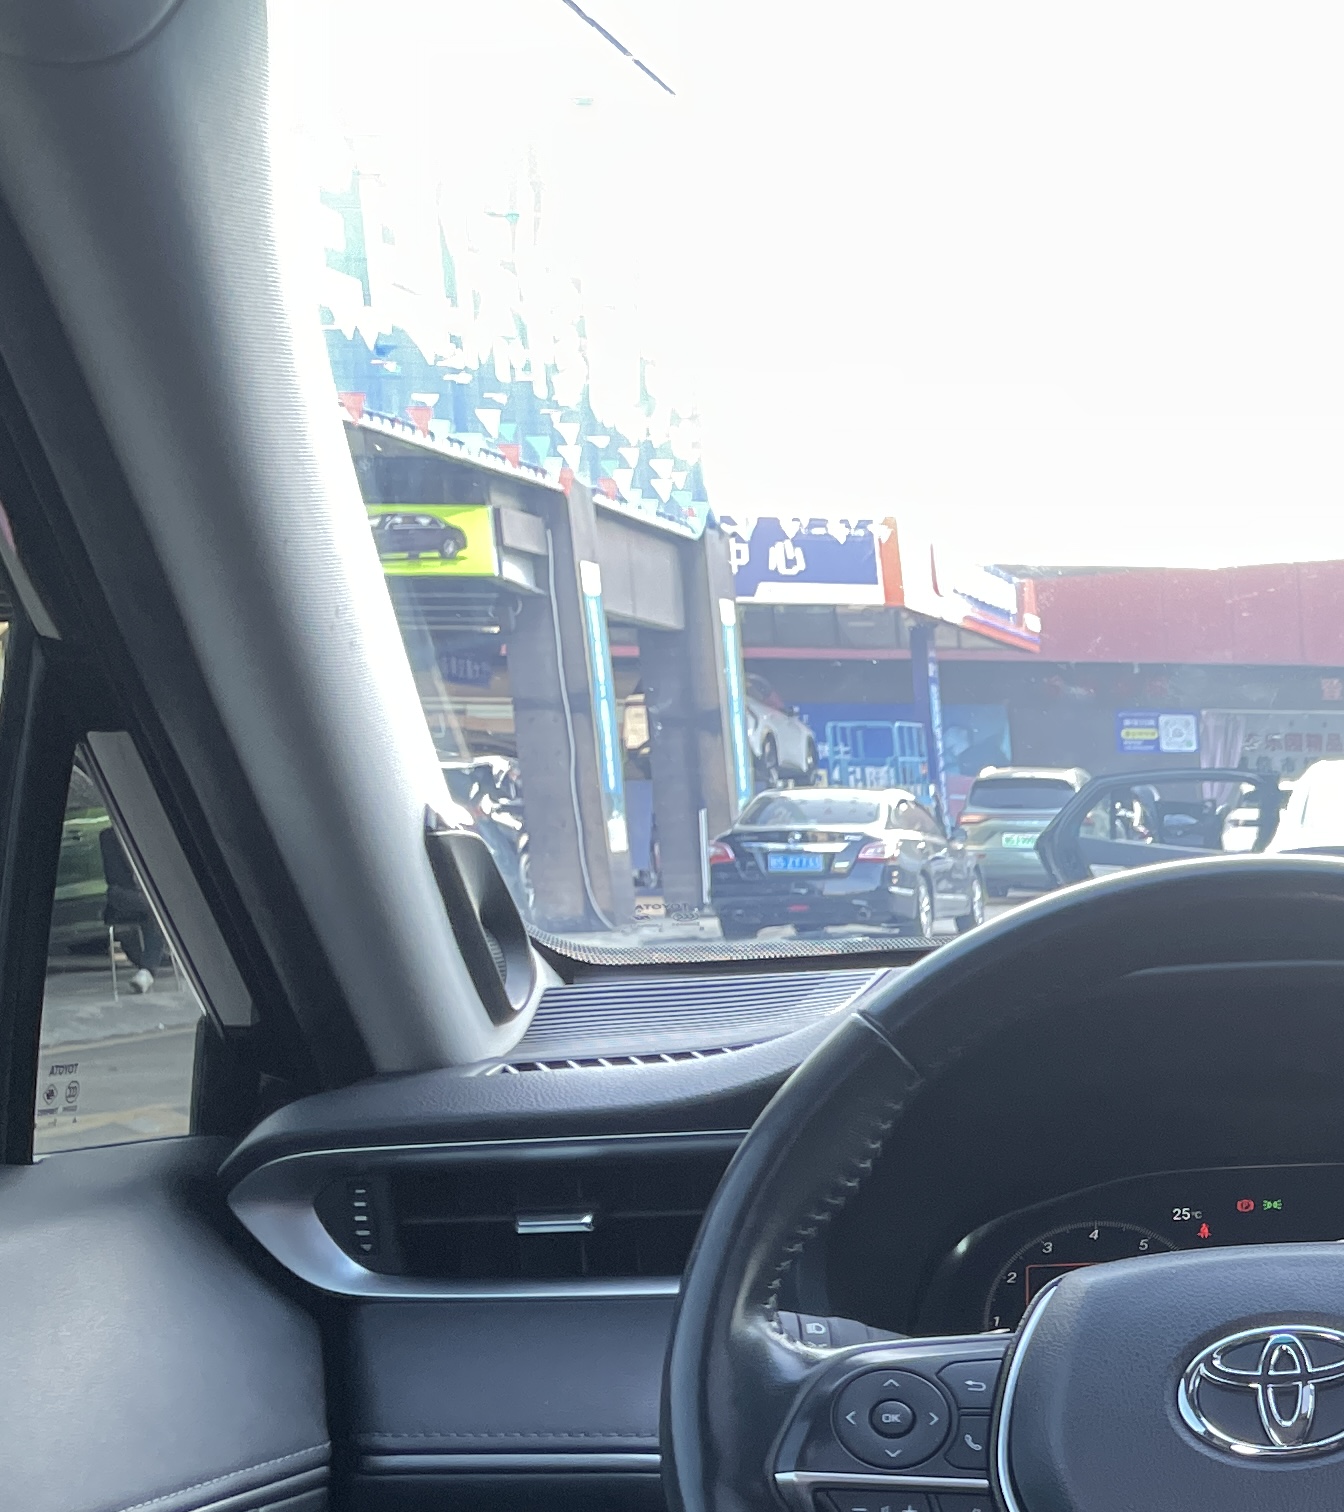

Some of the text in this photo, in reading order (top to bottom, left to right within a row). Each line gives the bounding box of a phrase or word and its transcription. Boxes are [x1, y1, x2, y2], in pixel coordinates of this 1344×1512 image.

[1089, 1229, 1099, 1240] 4
[1042, 1242, 1053, 1254] 3
[1138, 1238, 1149, 1250] 5
[1006, 1272, 1018, 1284] 2
[993, 1316, 1001, 1327] 1
[882, 1413, 902, 1424] OK
